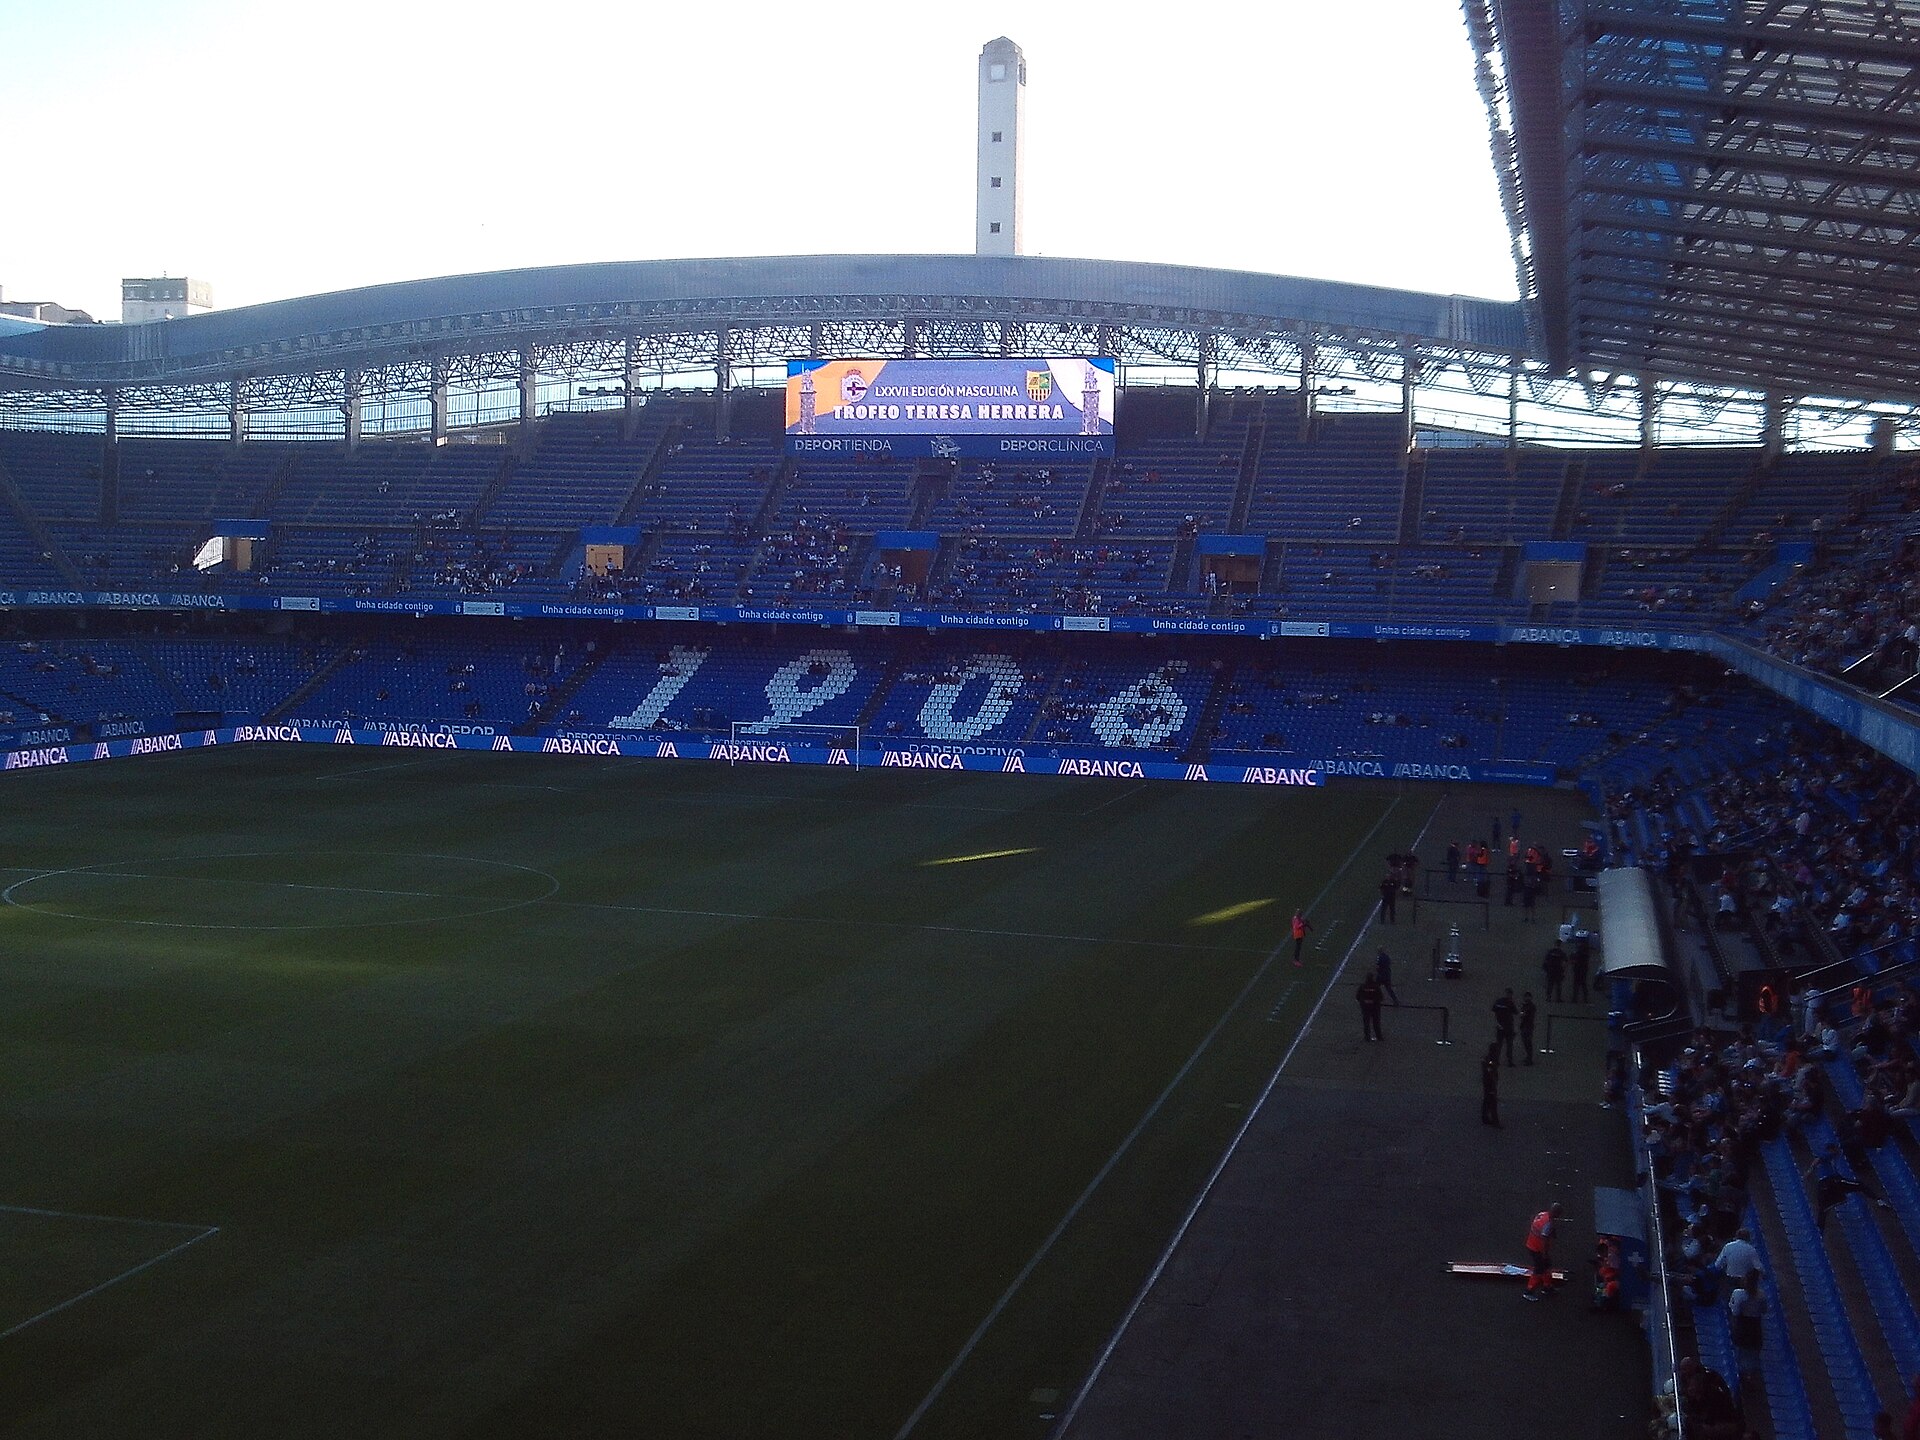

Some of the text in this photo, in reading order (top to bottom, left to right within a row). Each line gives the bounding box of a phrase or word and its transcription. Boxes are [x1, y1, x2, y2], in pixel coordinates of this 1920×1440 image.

[875, 383, 1020, 398] LXXVII EDICIÓN MASCULINA
[833, 403, 1065, 421] TROFEO TERESA HERRERA
[794, 439, 892, 452] DEPORTIENDA
[1000, 437, 1104, 452] DEPORCLÍNICA
[355, 600, 434, 613] Unha cidade contigo
[542, 605, 624, 618] Unha cidade contigo
[738, 610, 824, 623] Unha cidade contigo
[940, 615, 1030, 627] Unha cidade contigo
[1152, 619, 1246, 633] Unha cidade contigo
[1374, 625, 1471, 639] Unha cidade contigo
